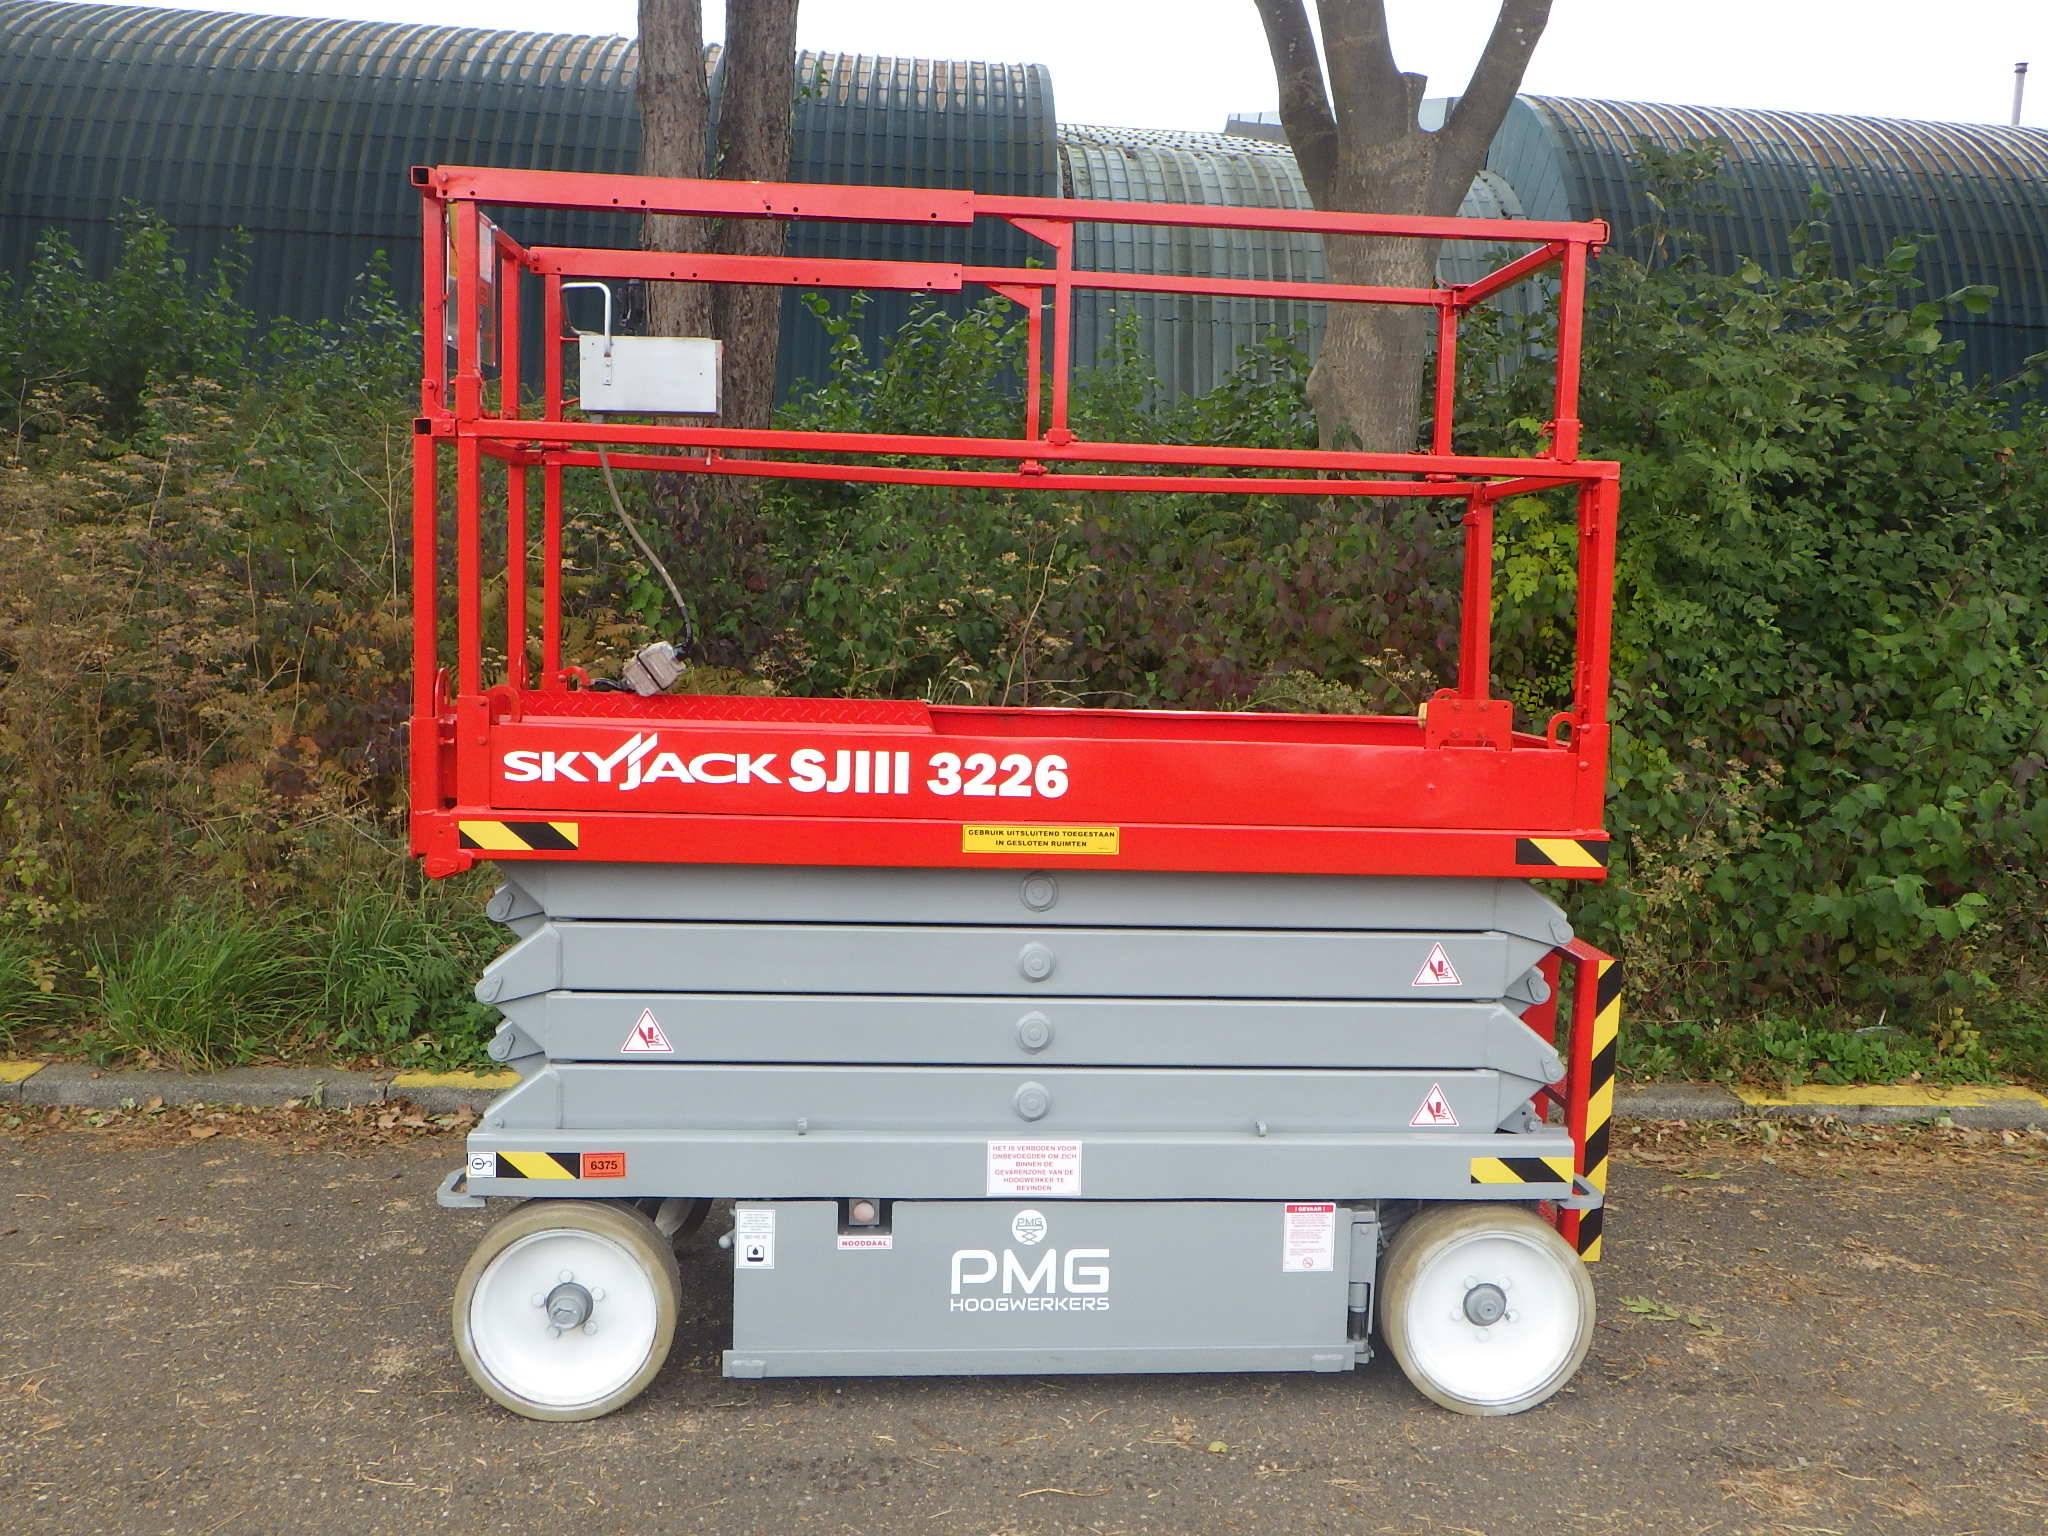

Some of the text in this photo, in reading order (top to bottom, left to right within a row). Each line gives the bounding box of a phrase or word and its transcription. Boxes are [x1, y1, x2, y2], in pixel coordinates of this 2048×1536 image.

[503, 732, 783, 791] SKYJACK
[927, 752, 1069, 798] 3226
[590, 1160, 618, 1171] 6375
[1017, 1217, 1042, 1226] PMG
[951, 1249, 1110, 1294] PMG
[950, 1297, 1110, 1312] HOOGWERKERS
